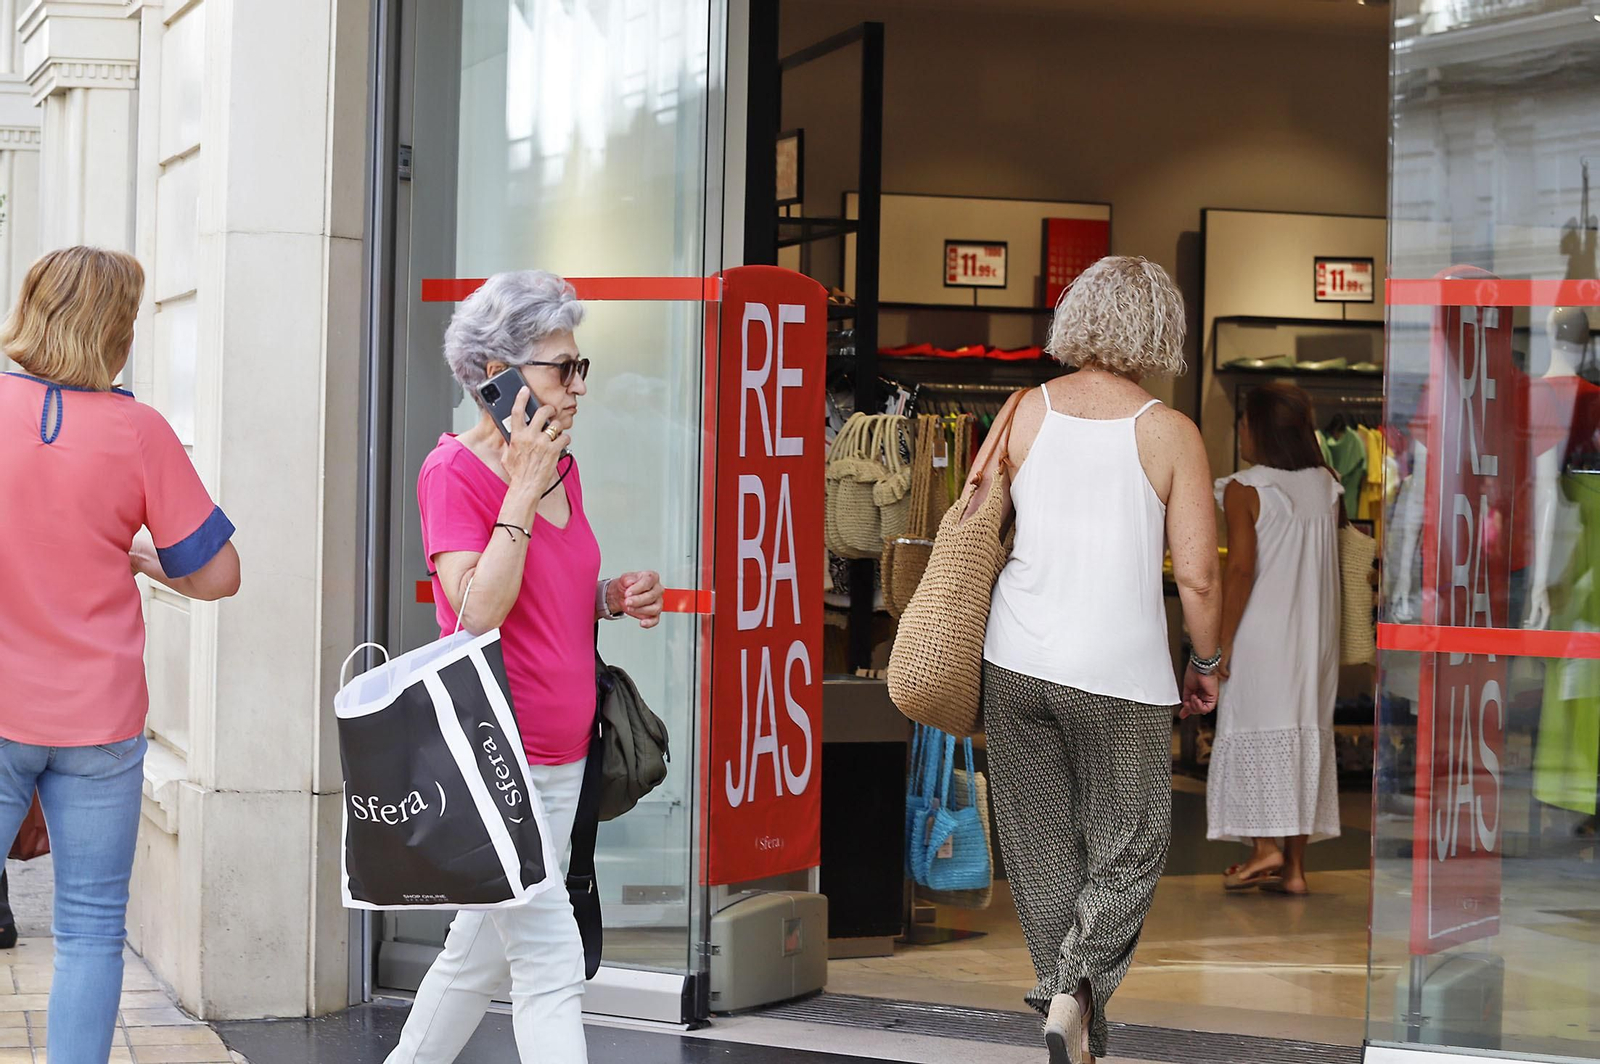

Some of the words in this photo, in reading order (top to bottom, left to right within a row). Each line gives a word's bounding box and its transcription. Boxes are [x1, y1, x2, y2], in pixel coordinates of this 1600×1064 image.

[739, 302, 806, 457] RE
[737, 473, 801, 630] BA
[725, 640, 812, 808] JAS
[1436, 680, 1502, 862] JAS
